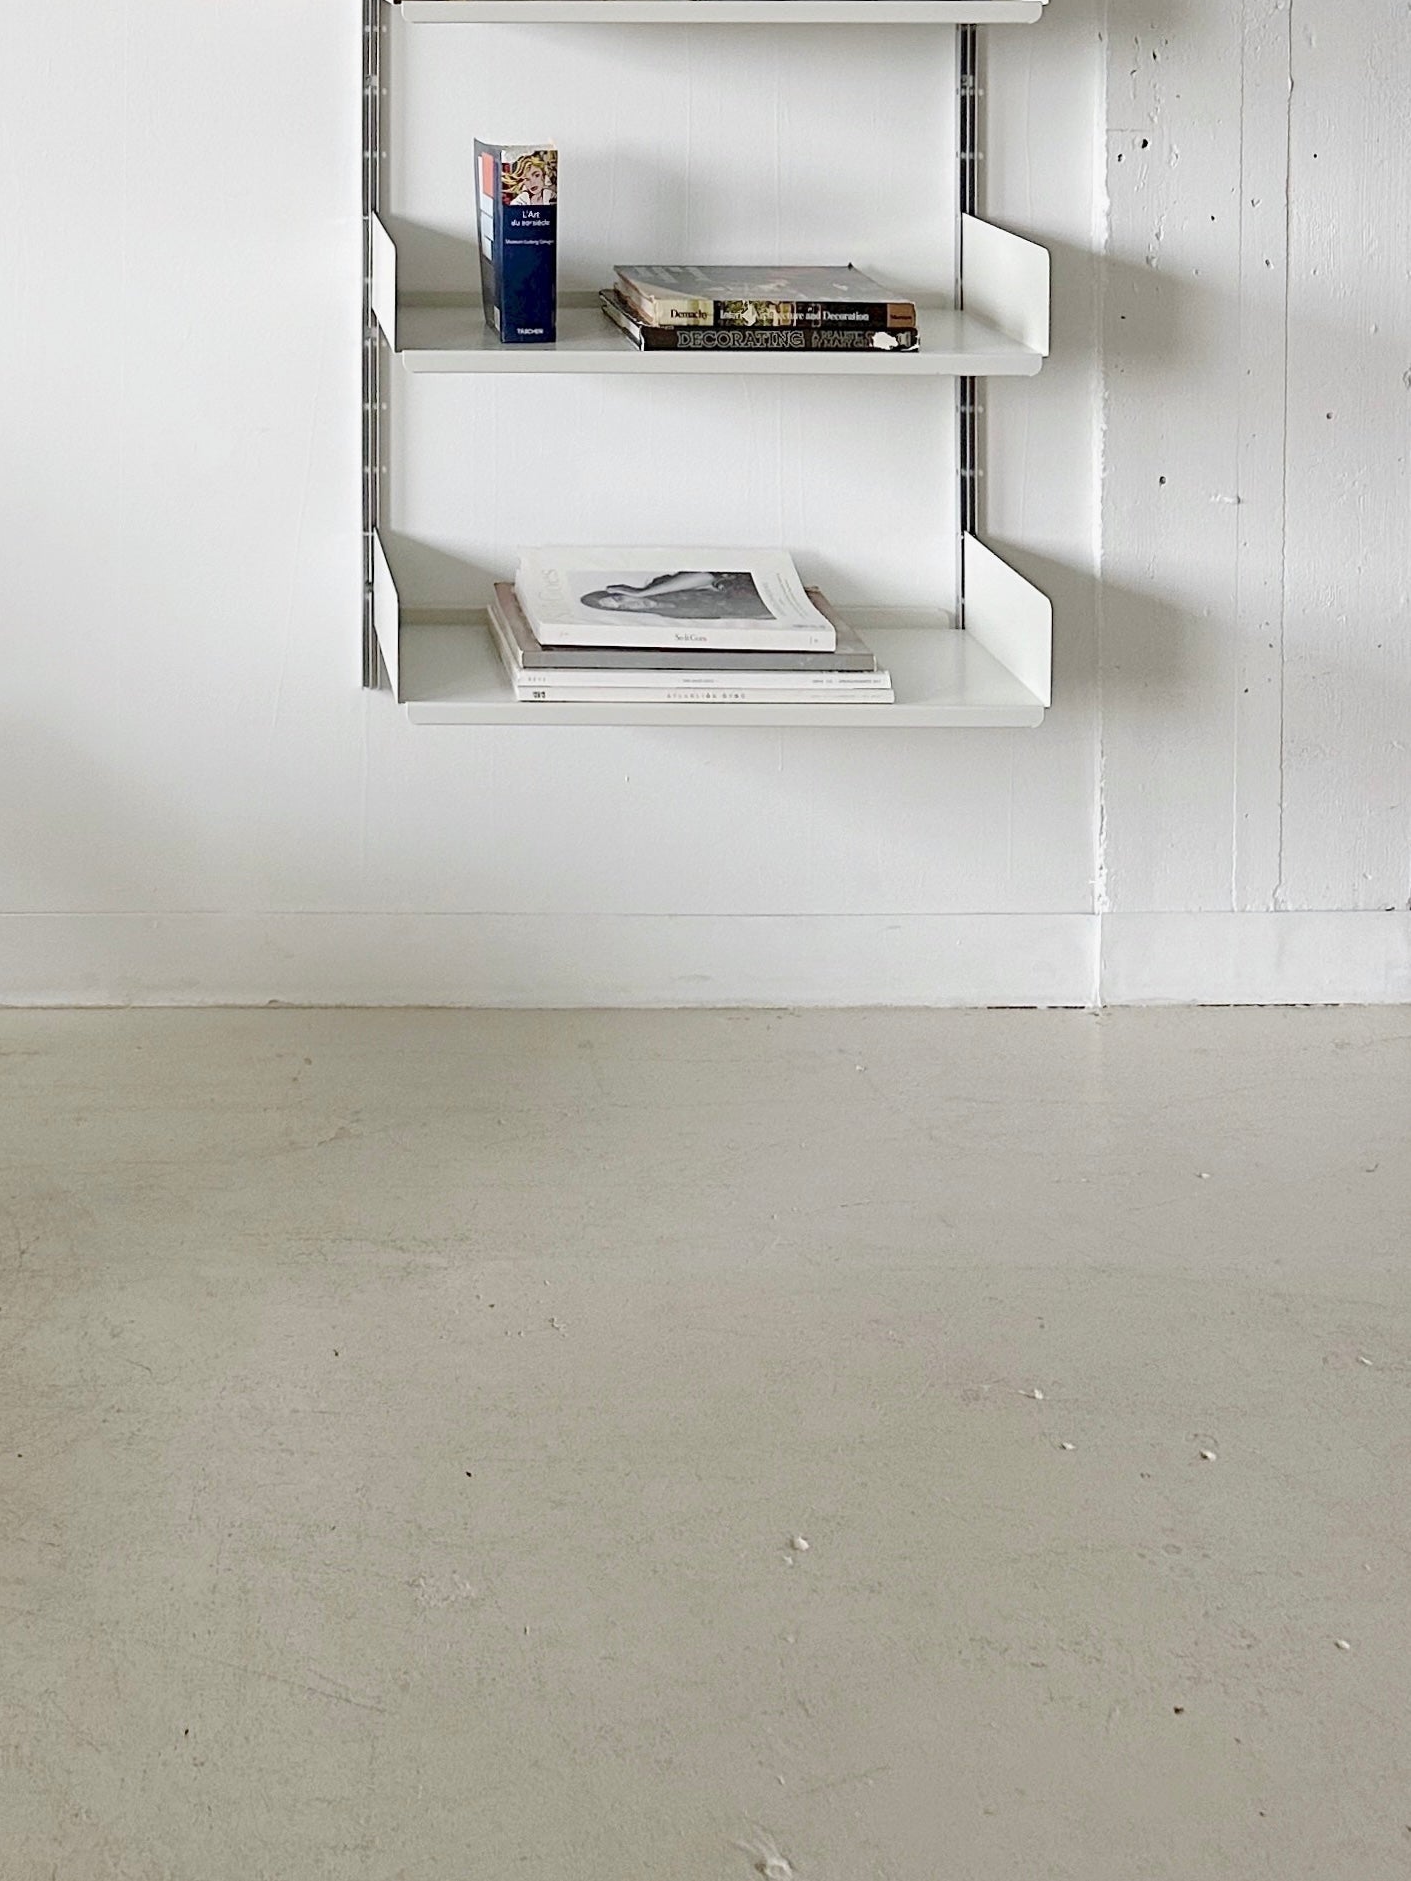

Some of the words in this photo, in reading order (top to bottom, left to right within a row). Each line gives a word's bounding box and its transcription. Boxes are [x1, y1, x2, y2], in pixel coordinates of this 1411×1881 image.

[805, 309, 822, 320] and
[822, 310, 870, 321] Decoration
[677, 330, 806, 348] DECORATING
